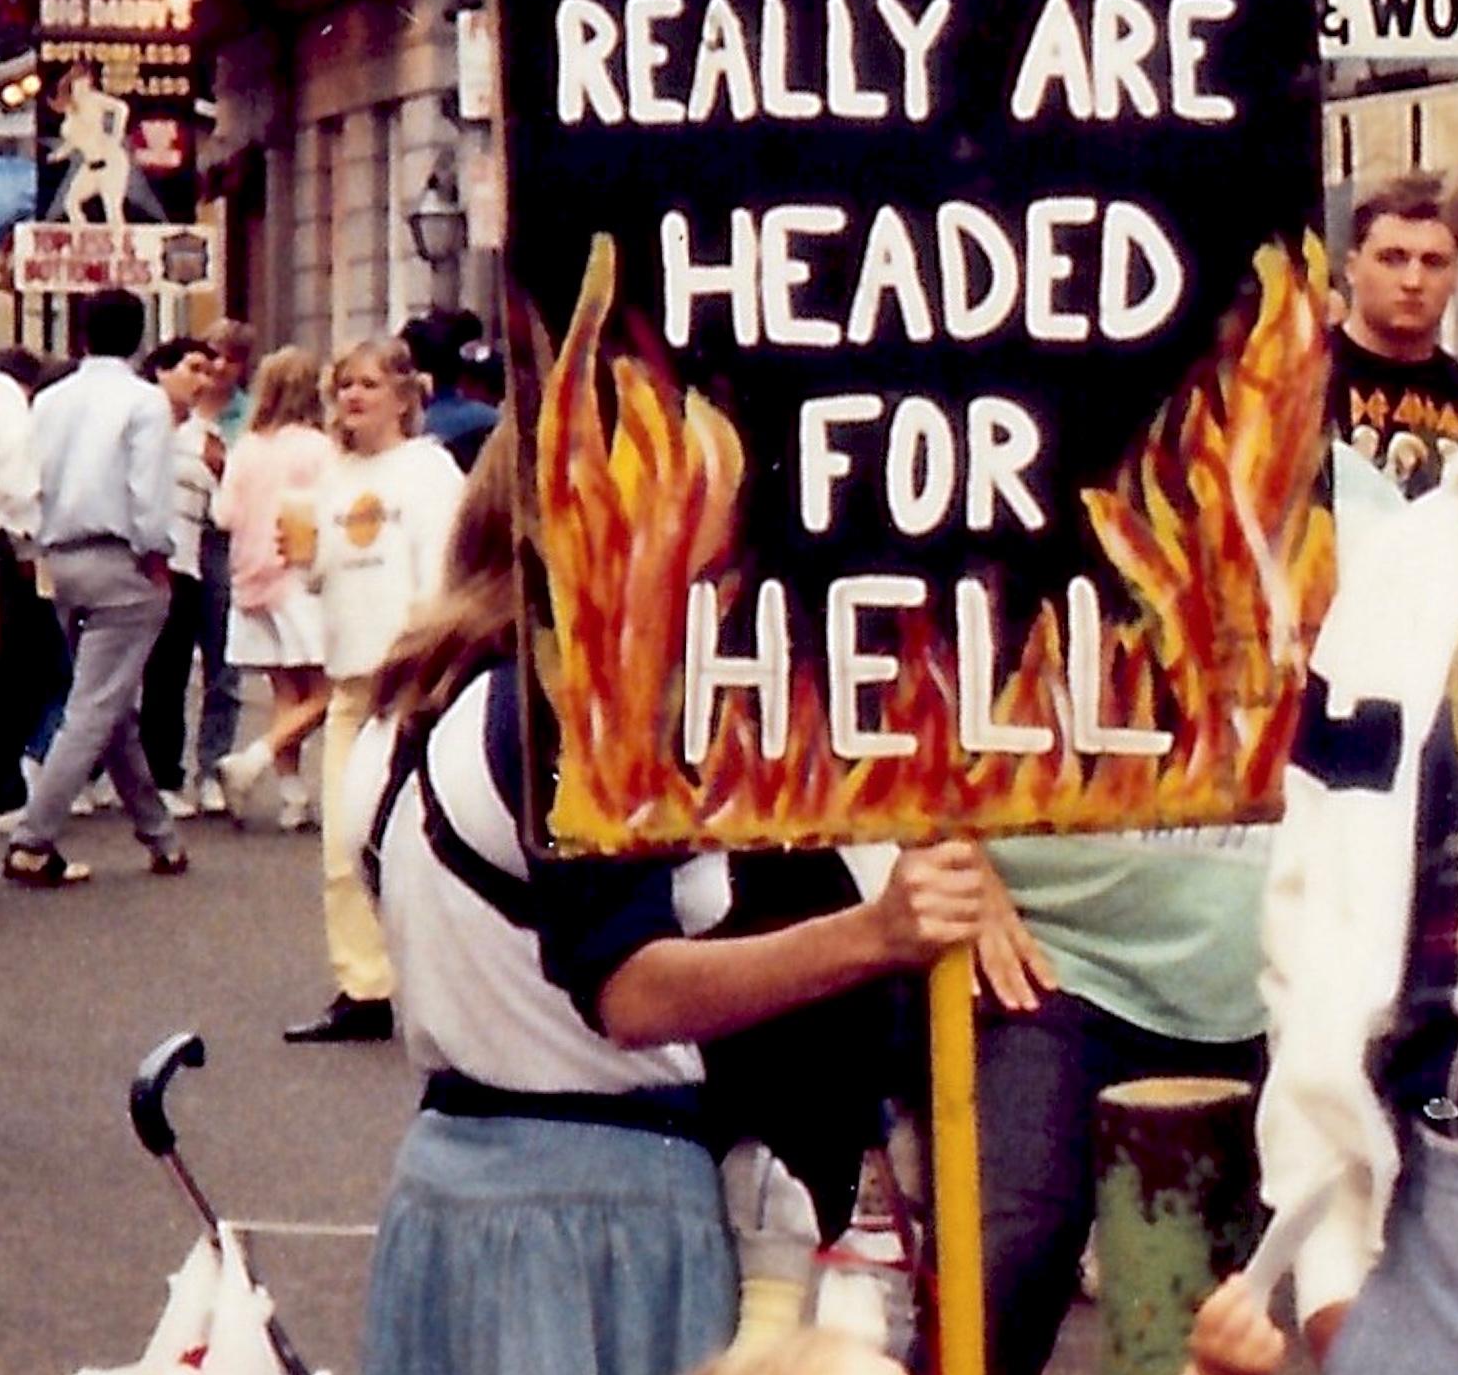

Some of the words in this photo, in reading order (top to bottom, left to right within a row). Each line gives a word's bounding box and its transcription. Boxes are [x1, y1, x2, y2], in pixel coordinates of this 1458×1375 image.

[660, 196, 1184, 349] HEADED
[799, 393, 1046, 536] FOR
[684, 574, 1176, 766] HELL
